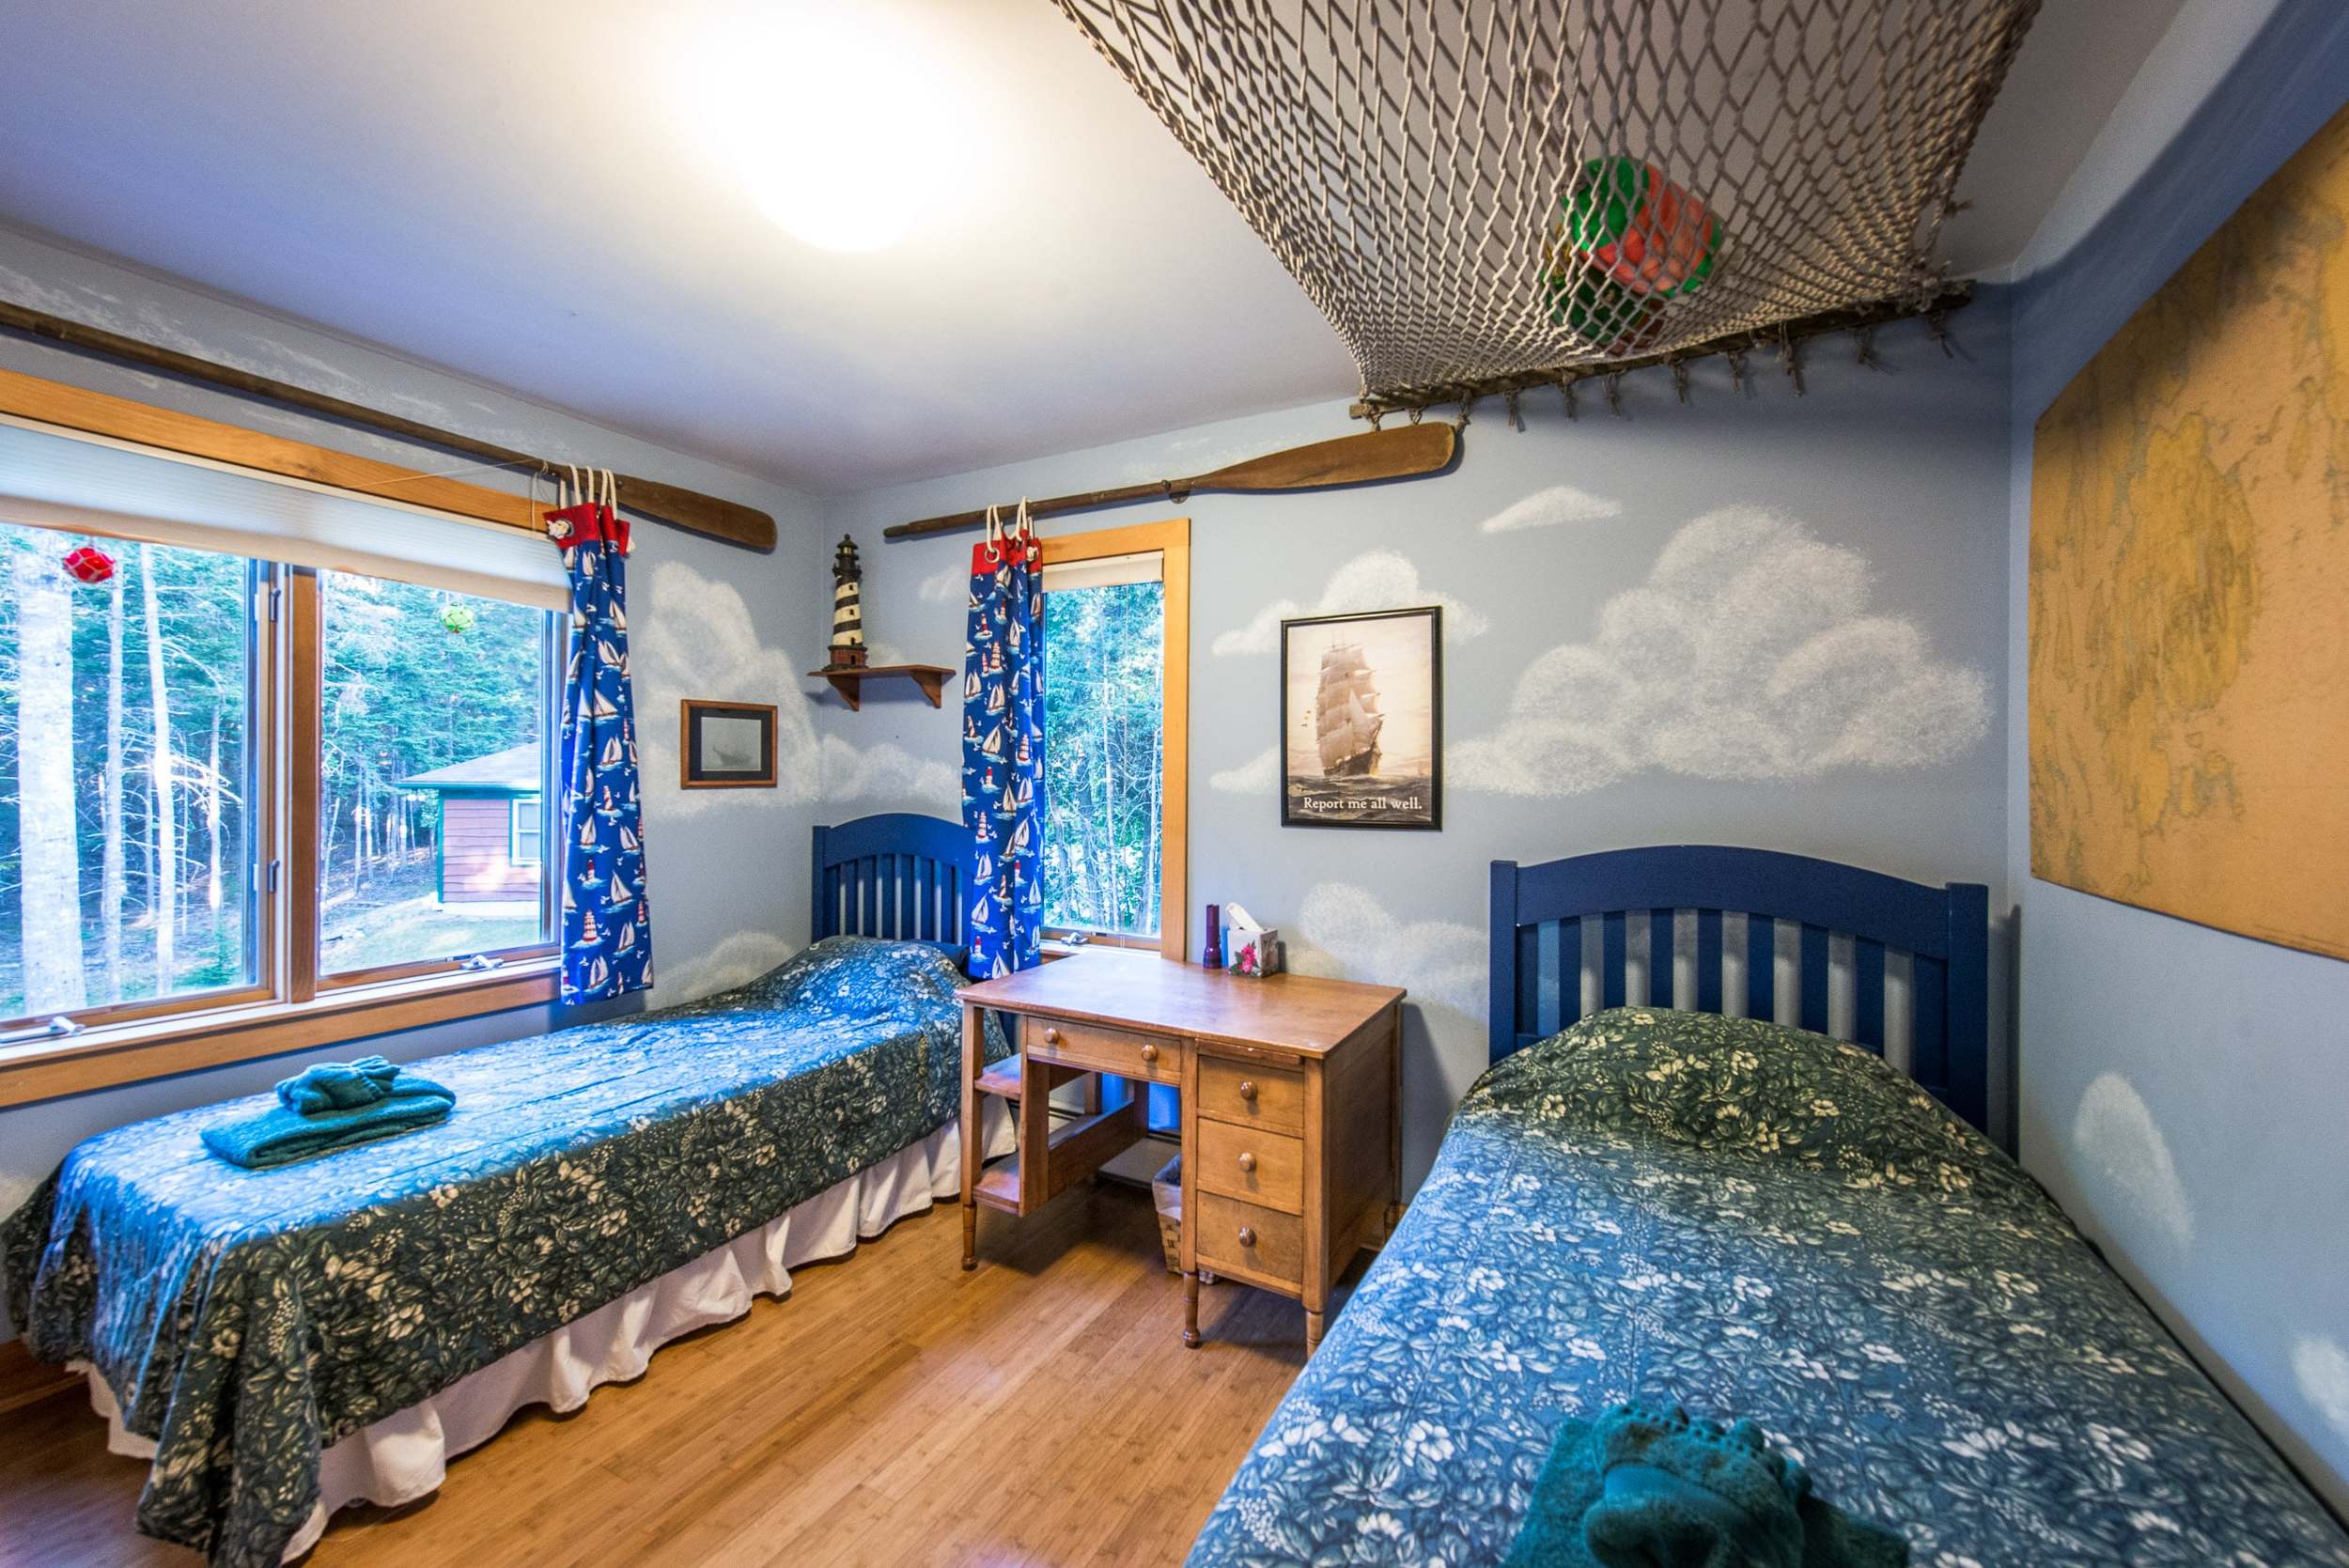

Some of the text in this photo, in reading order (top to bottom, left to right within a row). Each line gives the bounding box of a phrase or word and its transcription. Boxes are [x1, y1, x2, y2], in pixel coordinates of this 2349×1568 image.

[1304, 797, 1423, 812] Report me all well.
